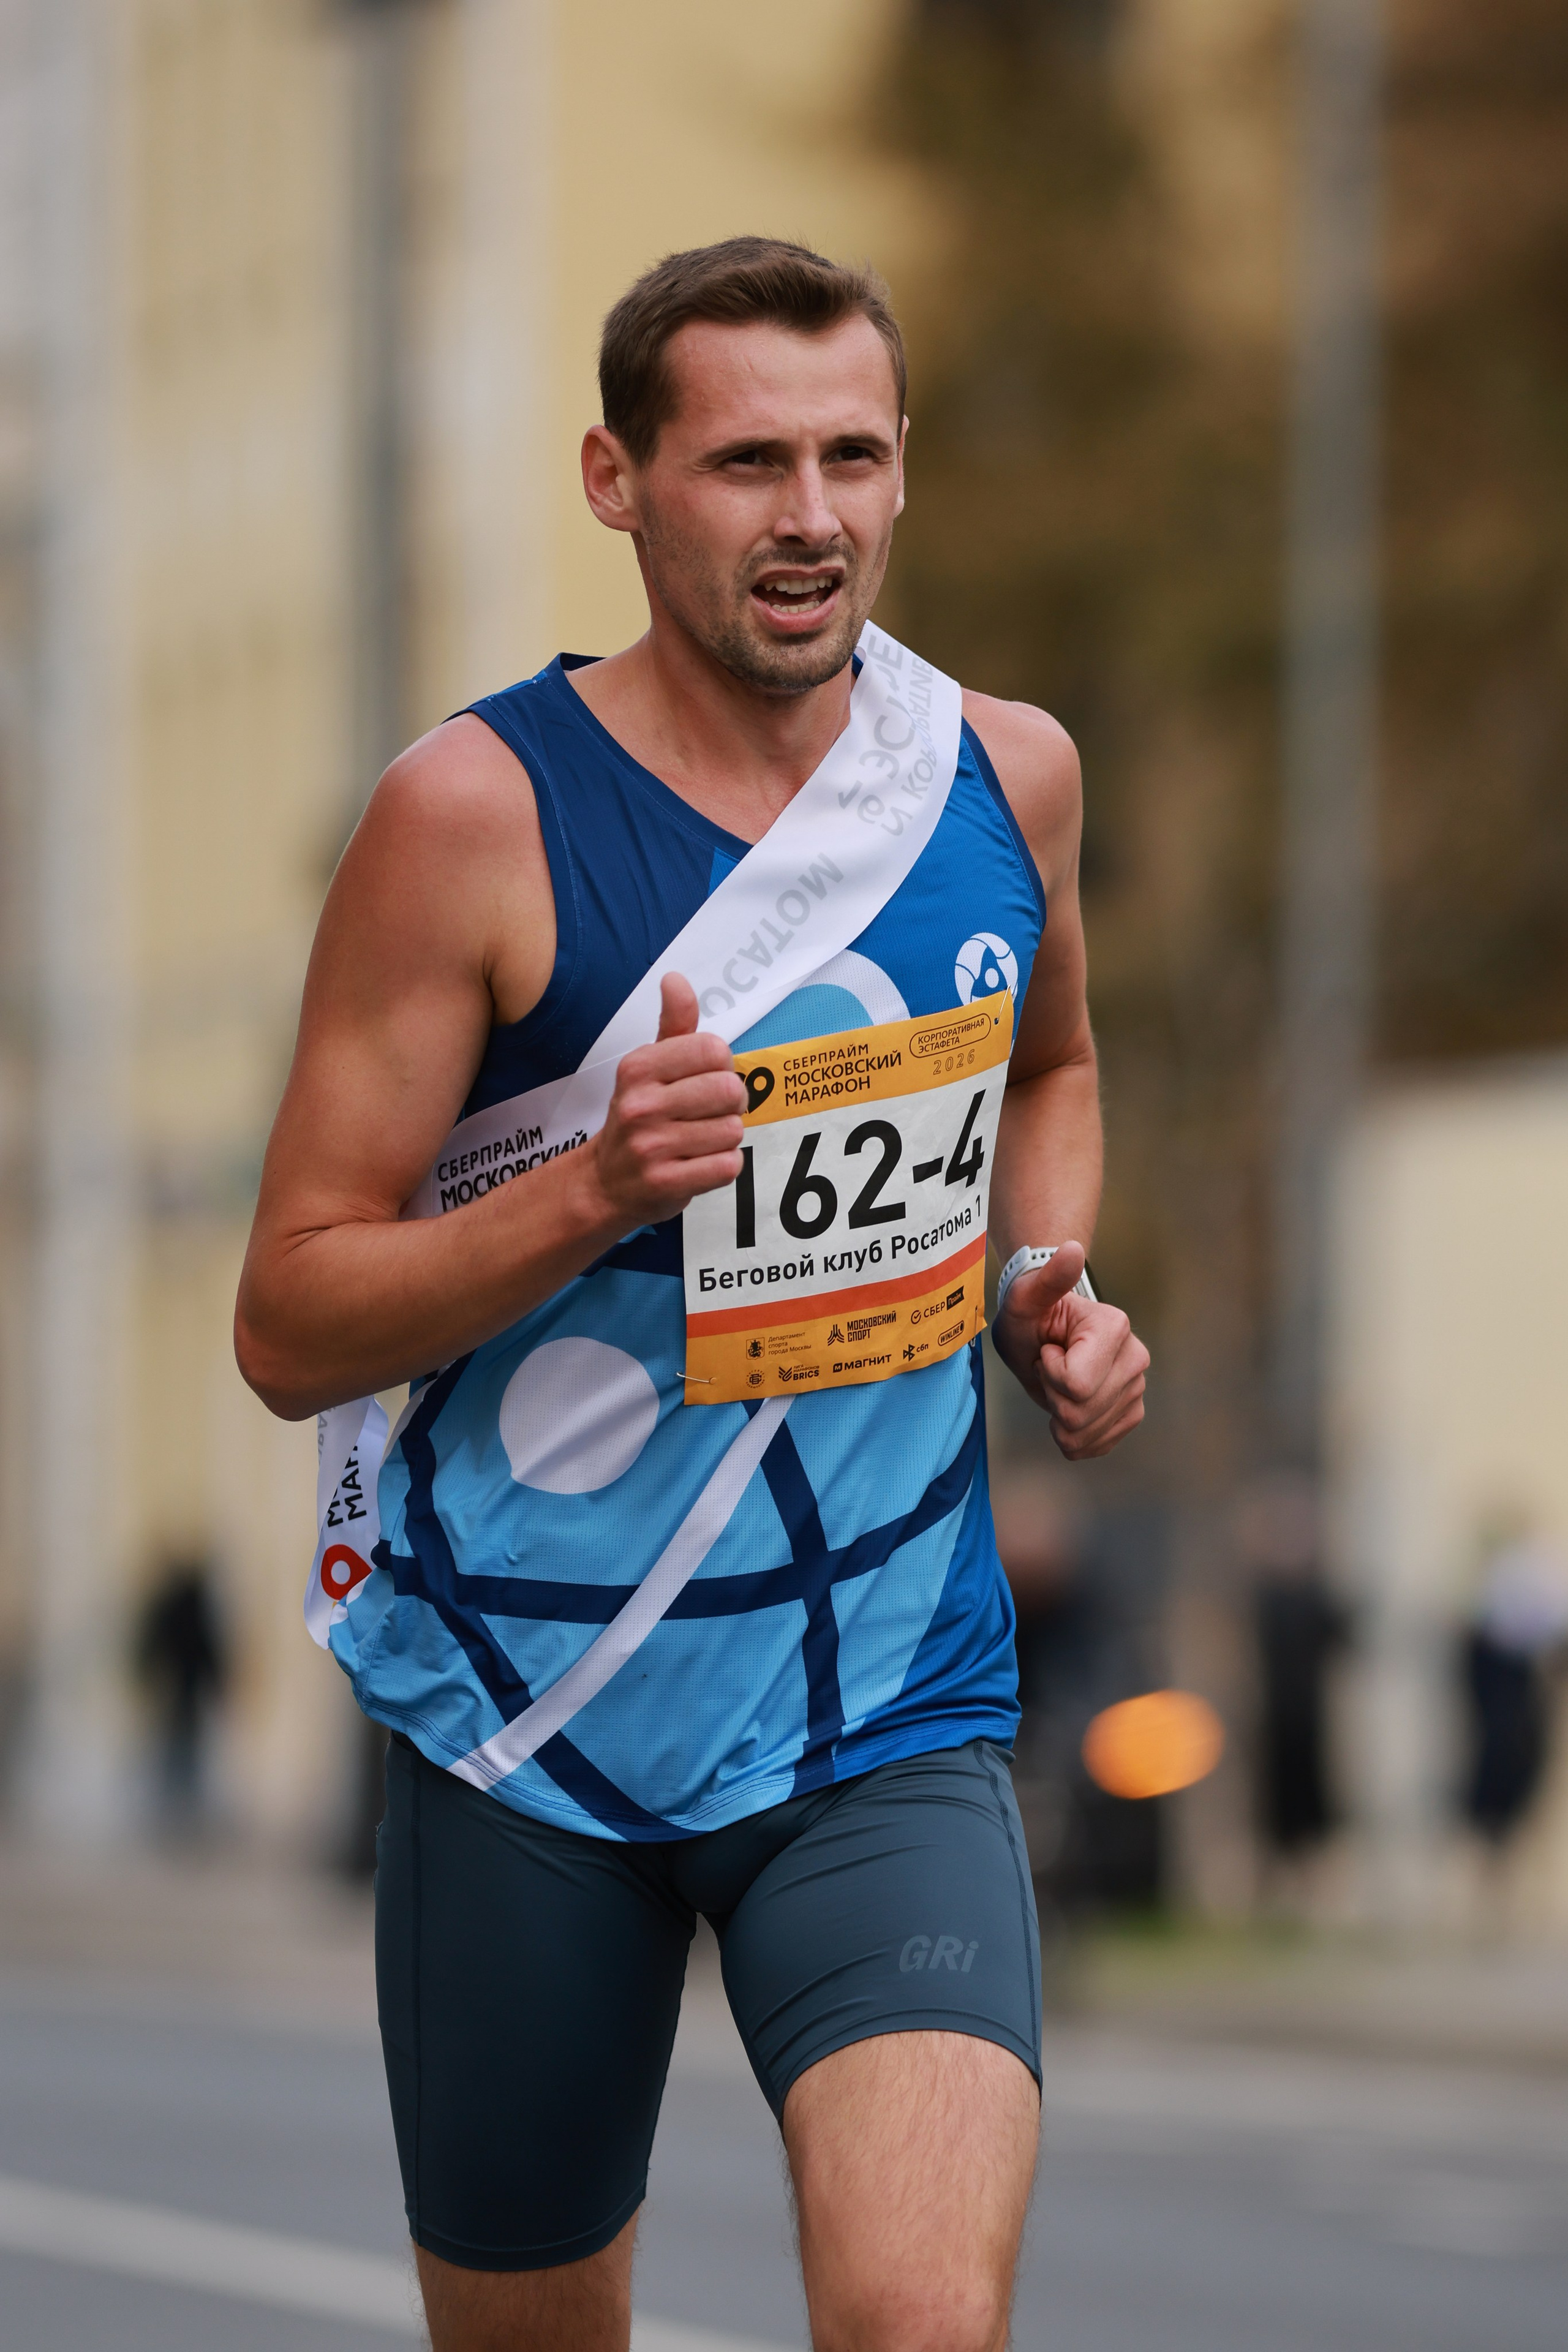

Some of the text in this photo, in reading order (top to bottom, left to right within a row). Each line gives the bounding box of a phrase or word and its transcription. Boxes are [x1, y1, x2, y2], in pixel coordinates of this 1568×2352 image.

[918, 1018, 985, 1045] КОРПОРАТИВНАЯ
[783, 1044, 869, 1072] СБЕРПРАЙМ
[918, 1037, 960, 1054] ЭСТАФЕТА
[783, 1050, 902, 1090] МОСКОВСКИЙ
[933, 1049, 976, 1076] 2026
[785, 1076, 871, 1107] МАРАФОН
[437, 1126, 543, 1182] СБЕРПРАЙМ
[736, 1089, 987, 1250] 162-4
[699, 1194, 981, 1292] Беговой клуб Росатома 1
[846, 1310, 897, 1332] МОСКОВСКИЙ
[923, 1302, 946, 1318] СБЕР
[768, 1332, 805, 1343] Департамент
[848, 1329, 871, 1343] СПОРТ
[940, 1325, 960, 1343] WINLINE
[793, 1370, 820, 1381] BRICS
